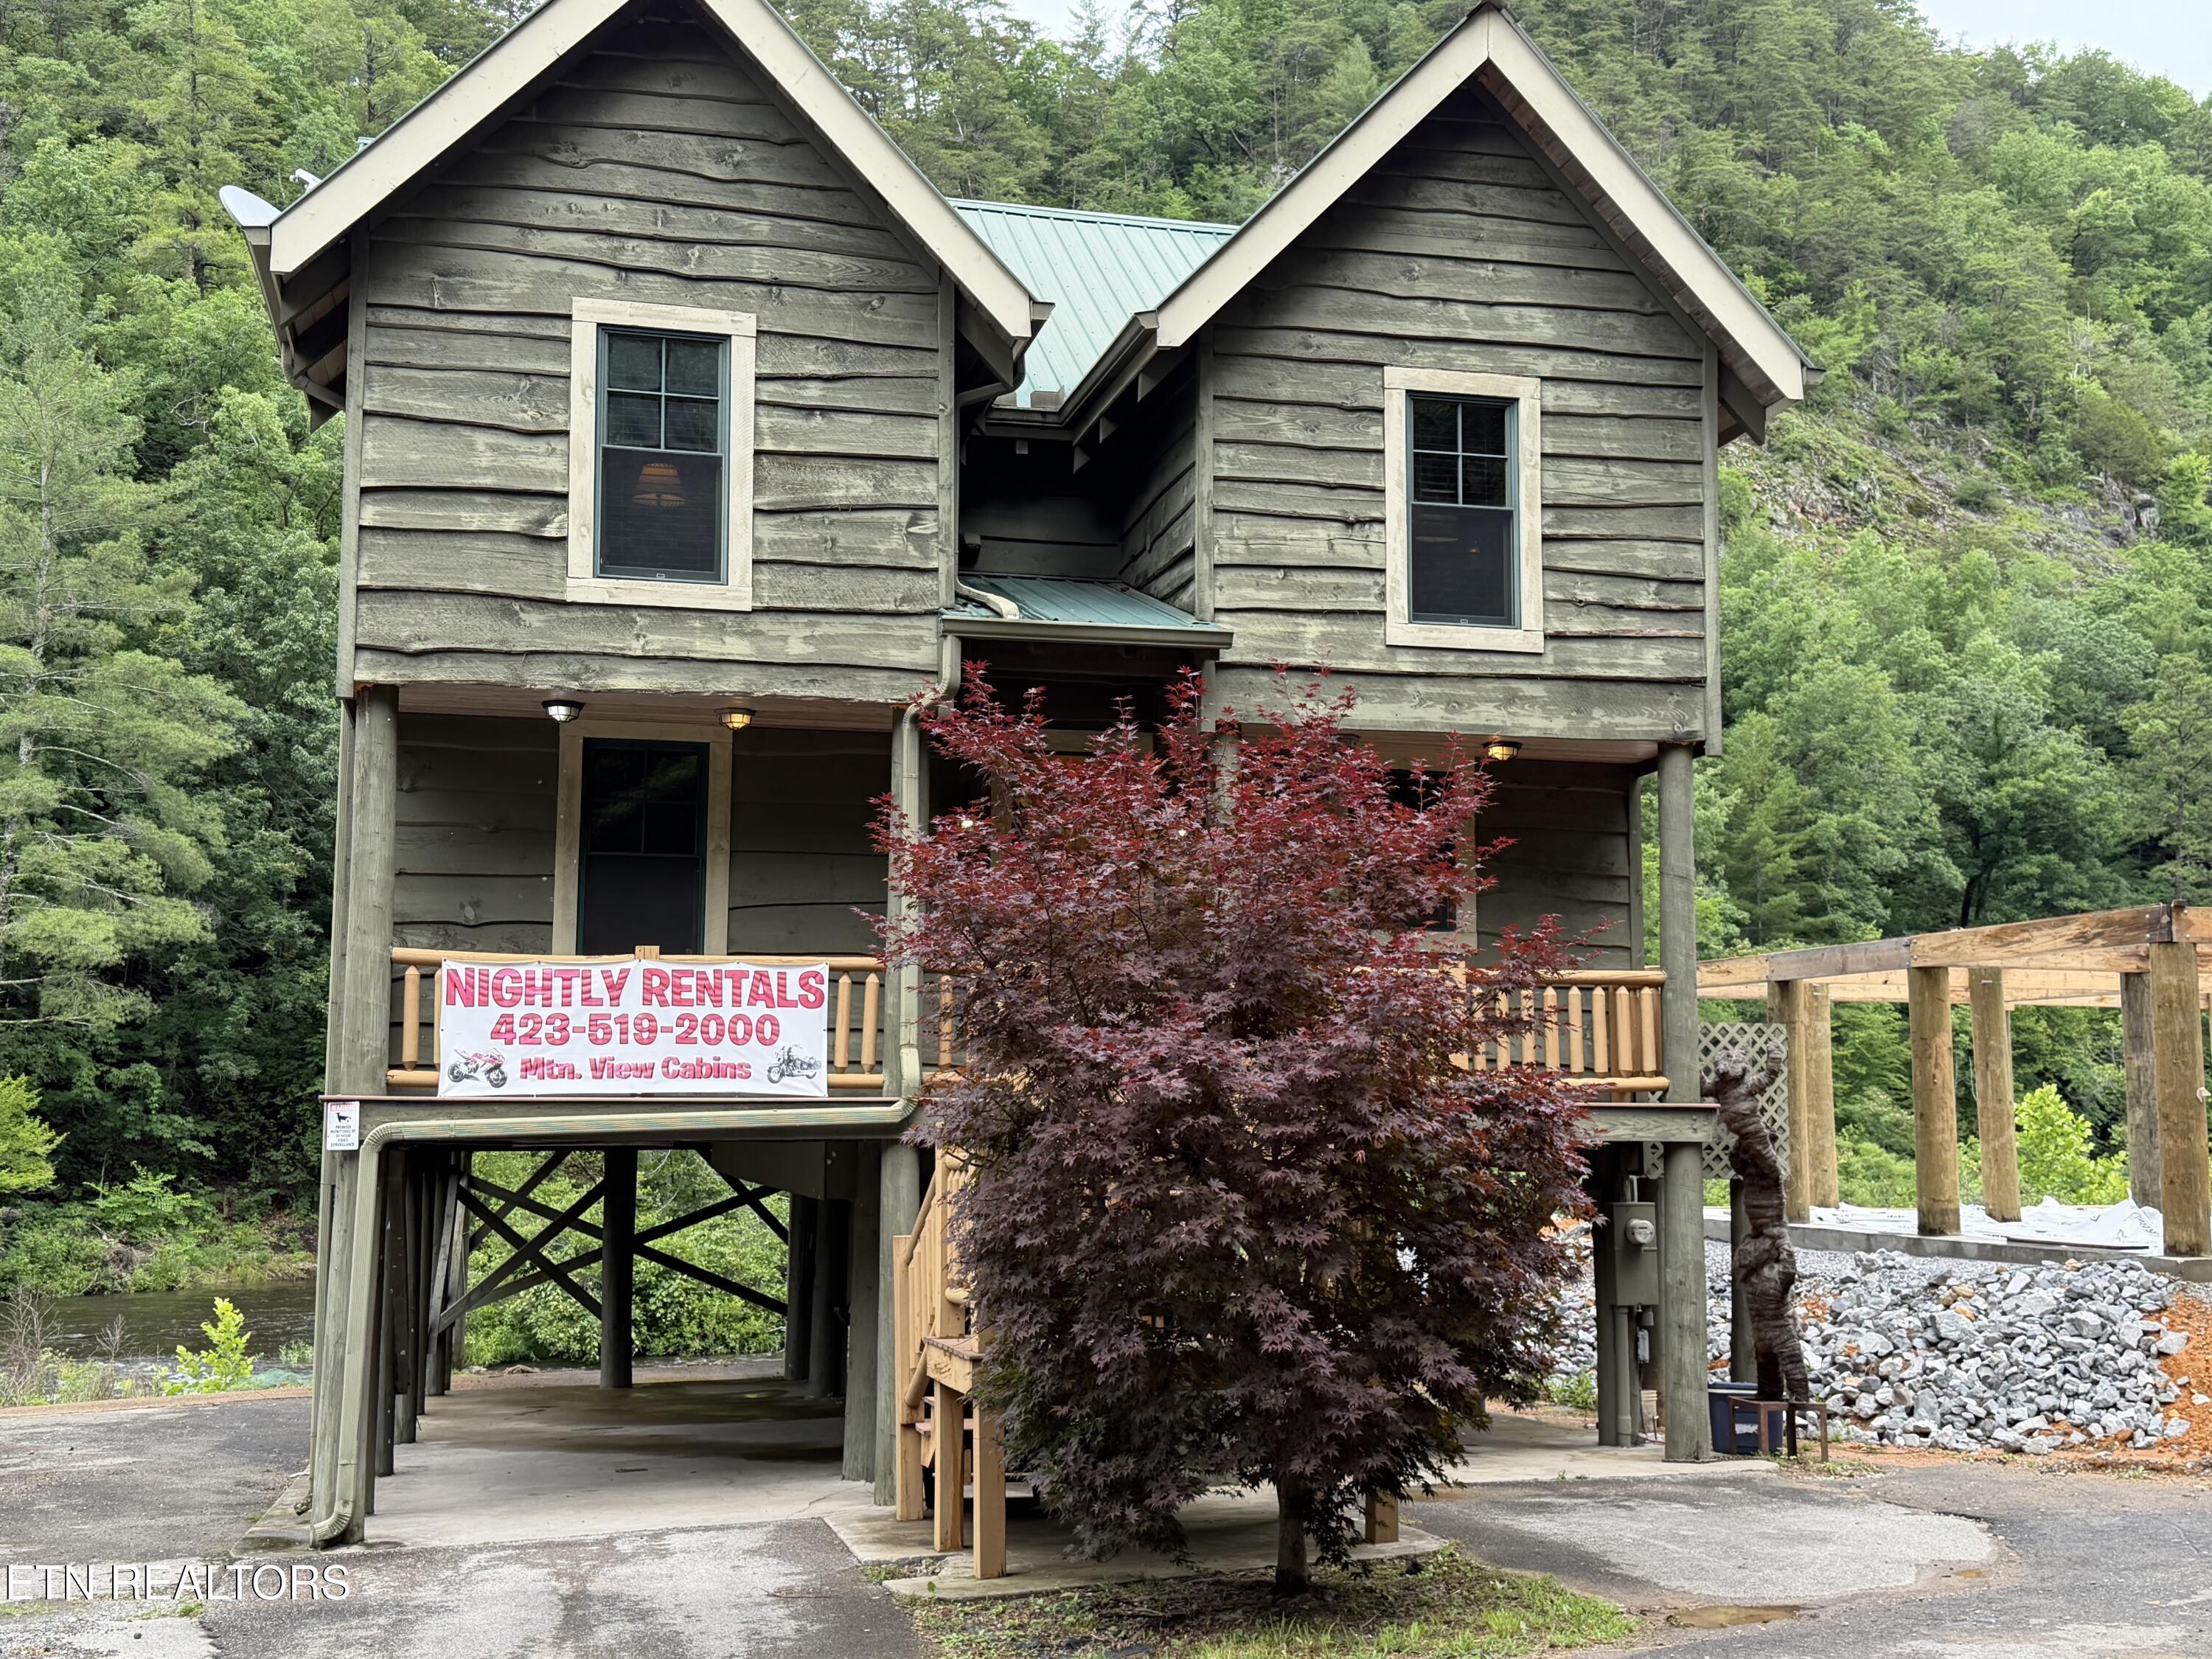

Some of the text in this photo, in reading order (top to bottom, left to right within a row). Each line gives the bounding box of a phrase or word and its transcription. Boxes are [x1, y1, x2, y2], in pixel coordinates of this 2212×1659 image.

[446, 967, 824, 1009] NIGHTLY RENTALS
[490, 1013, 779, 1046] 423-519-2000
[521, 1057, 751, 1079] Mtn. View Cabins
